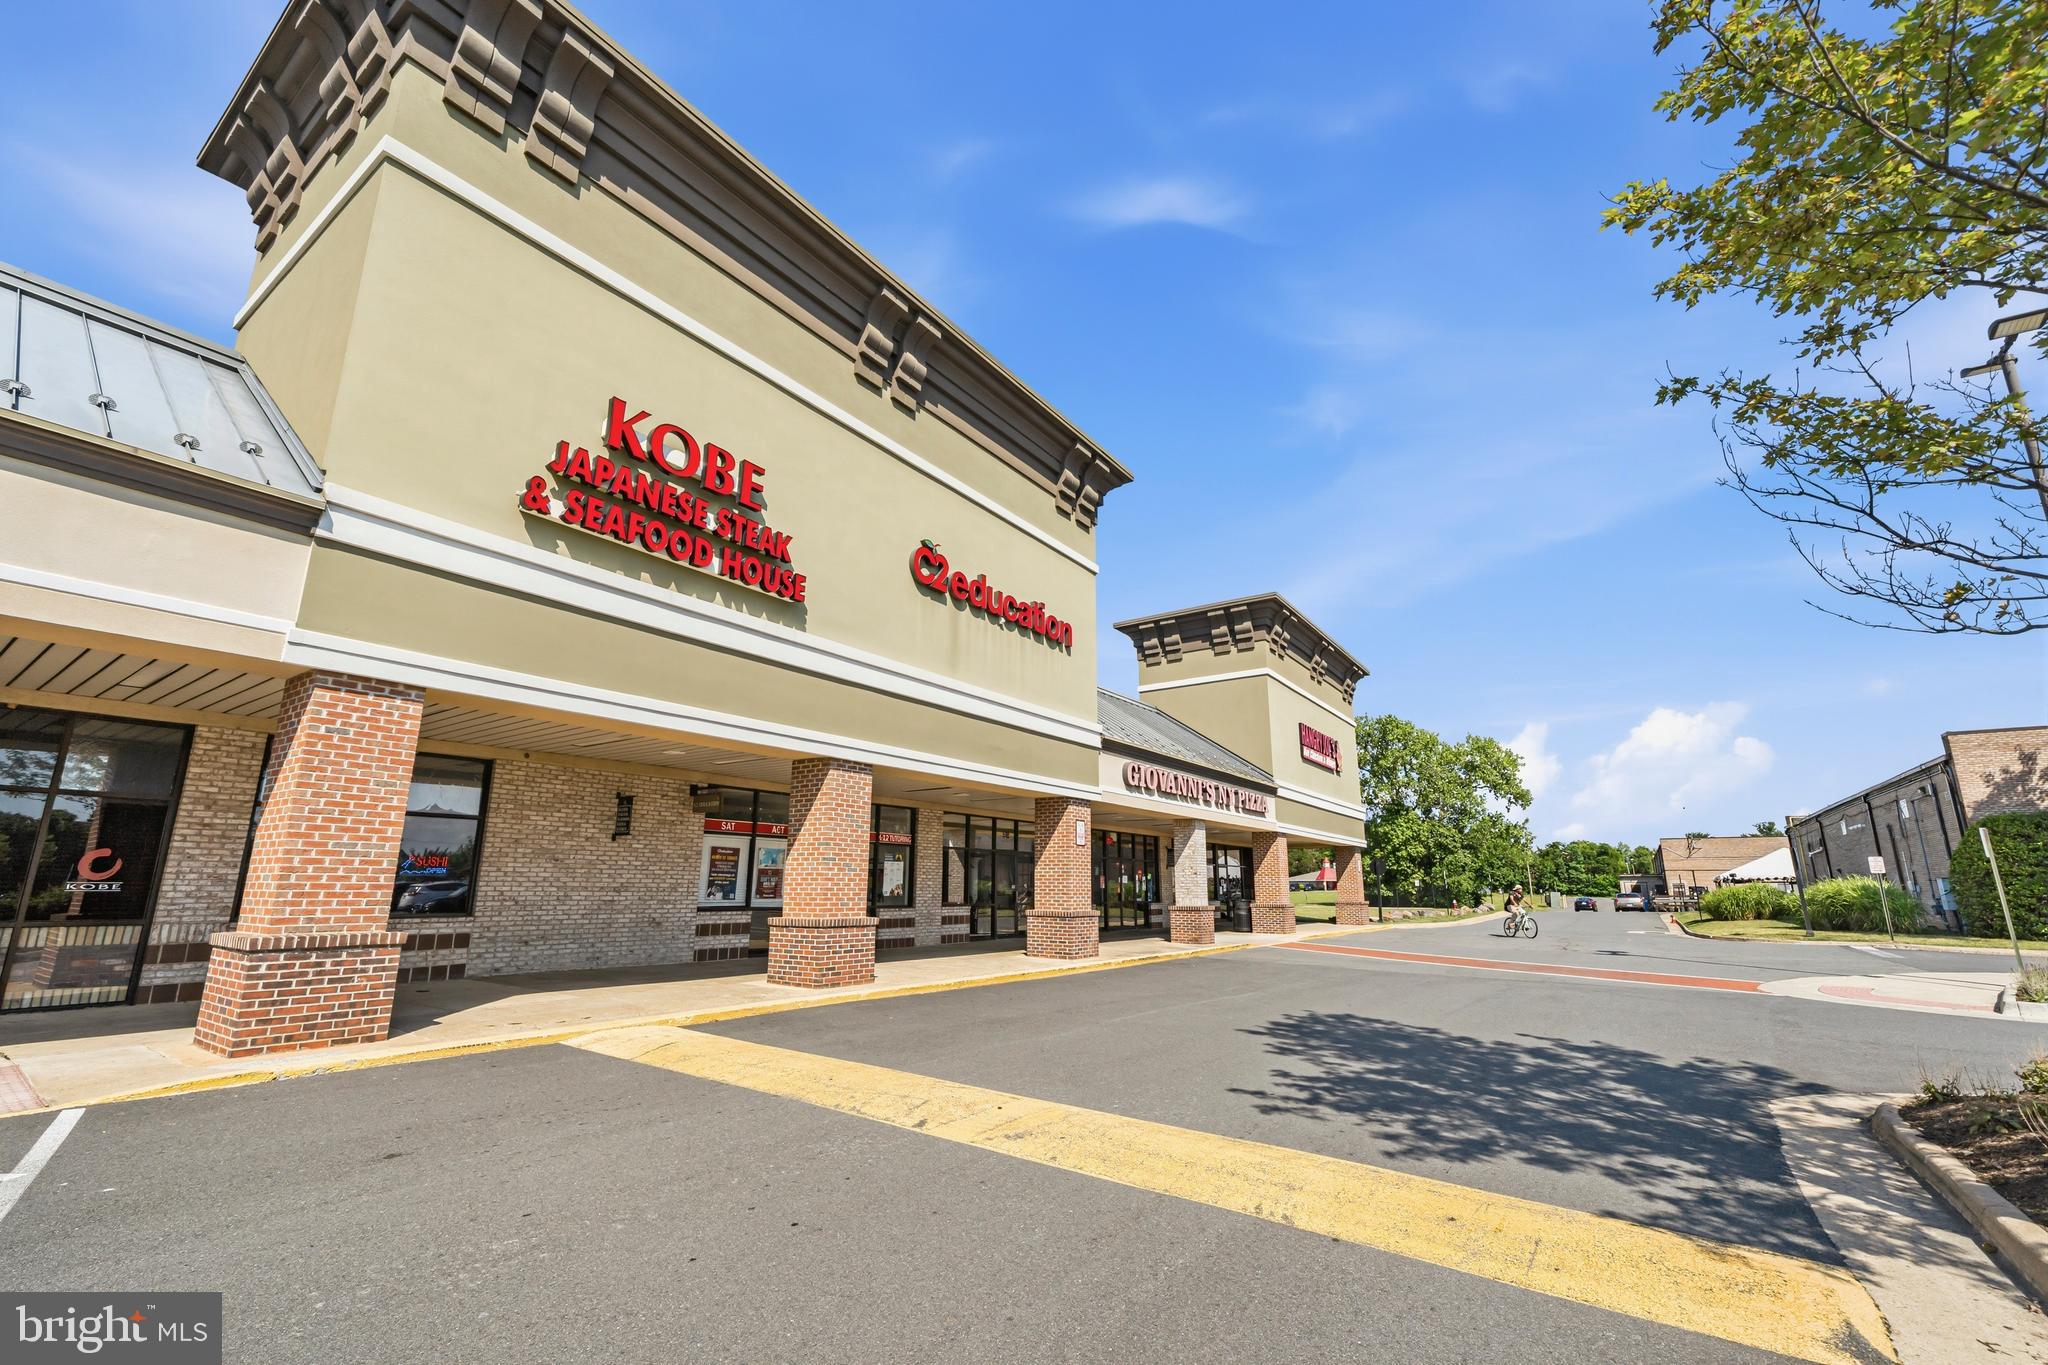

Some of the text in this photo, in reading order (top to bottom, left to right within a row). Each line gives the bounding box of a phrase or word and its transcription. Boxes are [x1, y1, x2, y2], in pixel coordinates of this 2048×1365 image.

[603, 396, 766, 512] KOBE
[546, 439, 793, 563] JAPANESE STEAK
[518, 475, 807, 602] & SEAFOOD HOUSE
[1125, 761, 1269, 812] GIOVANNI'S NY PIZZA
[721, 821, 736, 831] SAT
[771, 825, 785, 834] ACT
[416, 856, 449, 867] SUSHI
